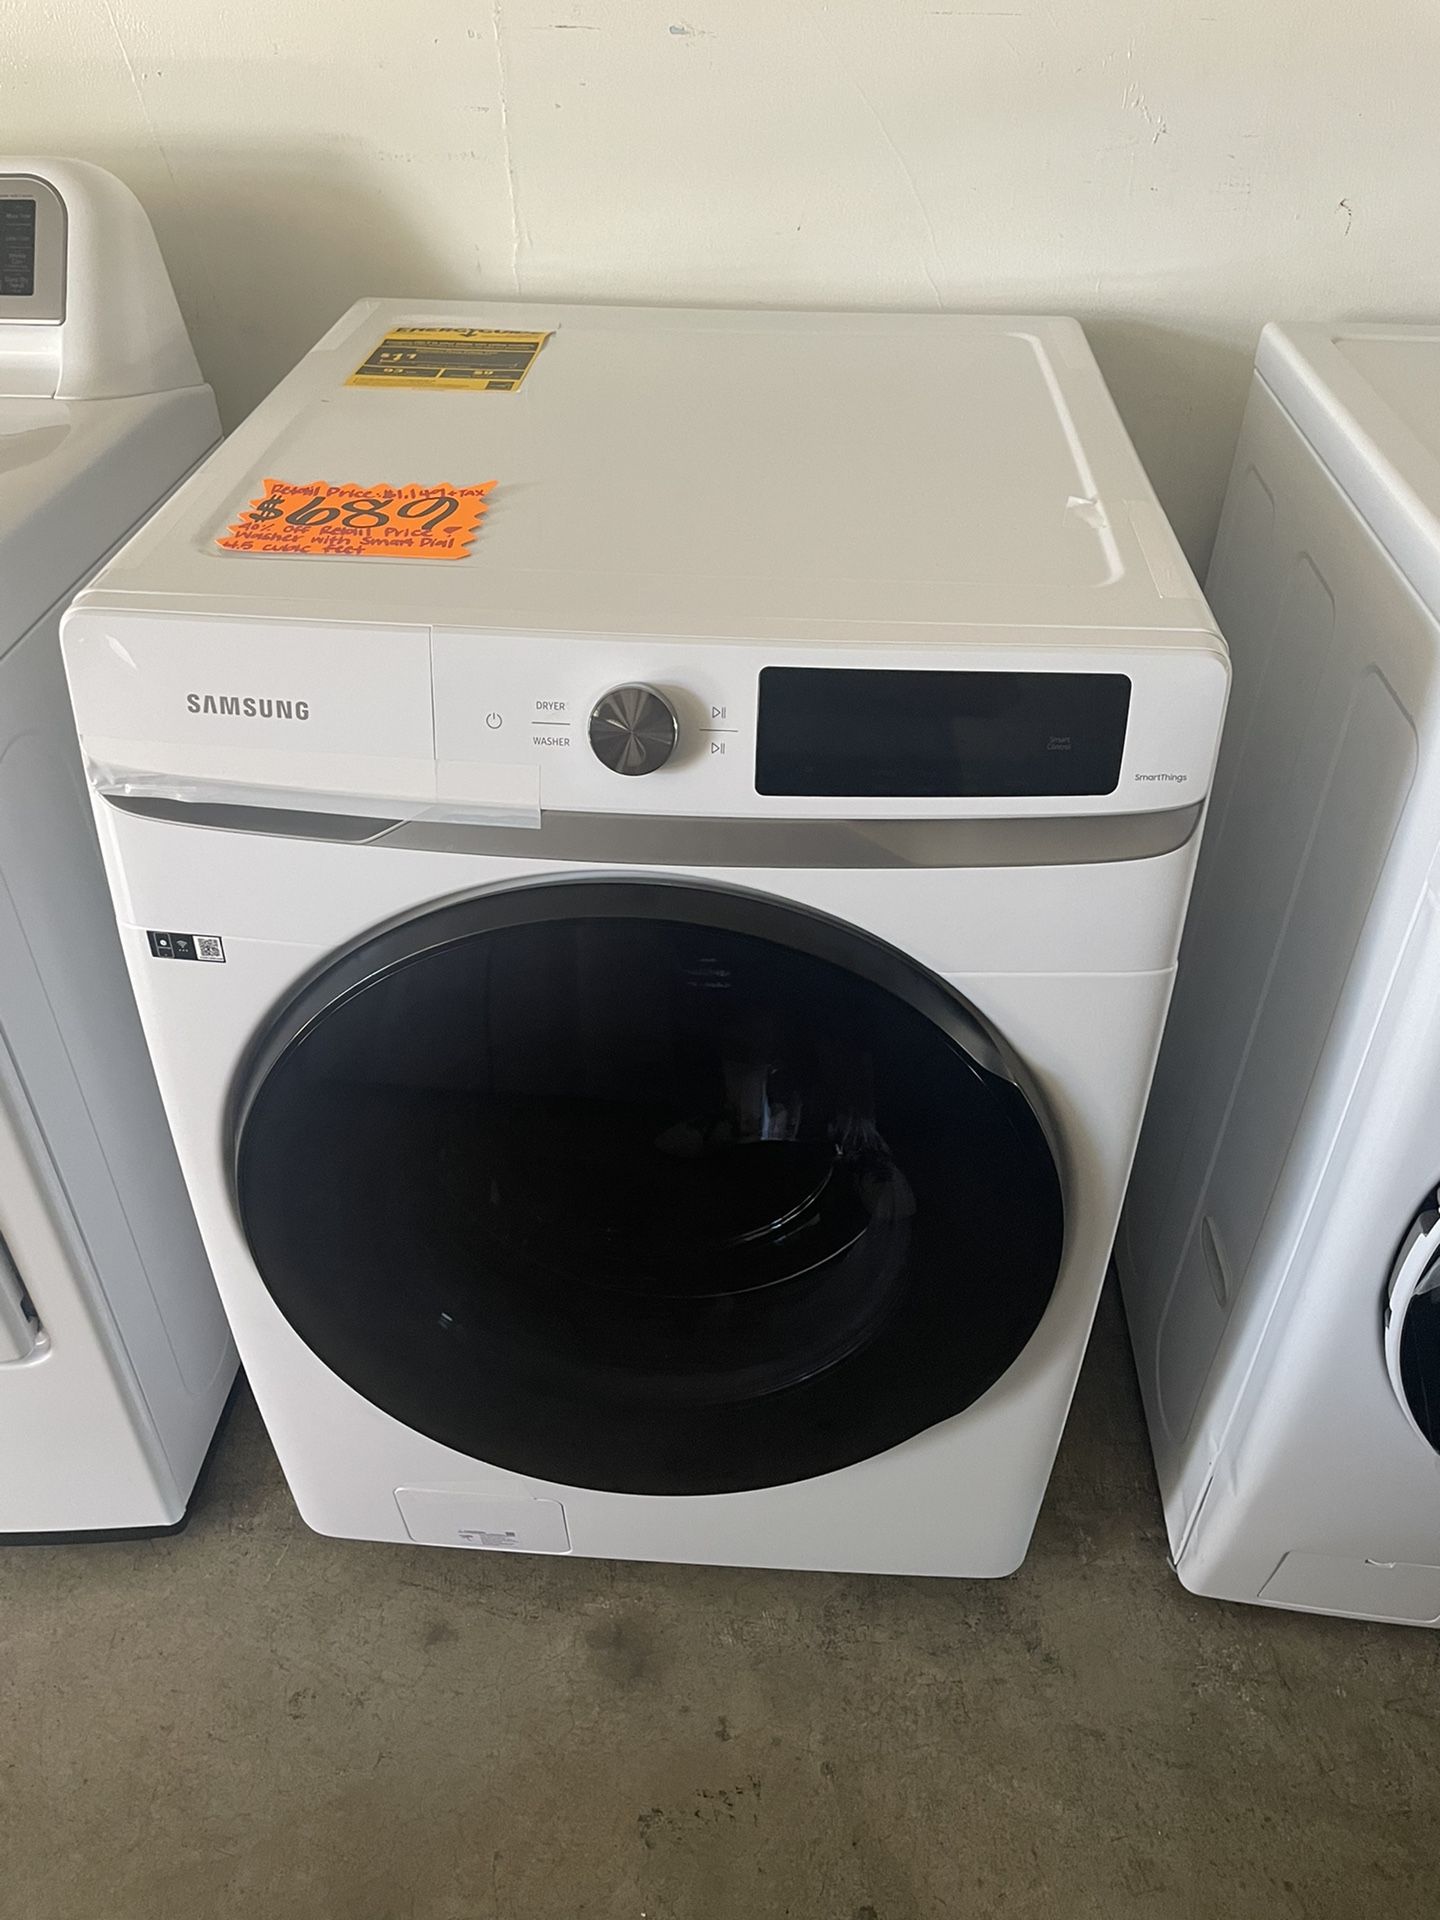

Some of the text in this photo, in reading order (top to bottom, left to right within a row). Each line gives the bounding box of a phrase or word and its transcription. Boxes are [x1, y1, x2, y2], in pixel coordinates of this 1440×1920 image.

[271, 484, 320, 496] Retail
[249, 494, 459, 531] $689
[238, 522, 275, 532] 40%
[320, 525, 371, 537] Retail
[222, 541, 254, 550] 4.5
[360, 535, 414, 547] Smart
[420, 537, 455, 549] Dial
[186, 693, 310, 721] SAMSUNG
[535, 700, 566, 711] DRYER
[532, 736, 571, 747] WASHER
[1134, 773, 1188, 784] SmartThings
